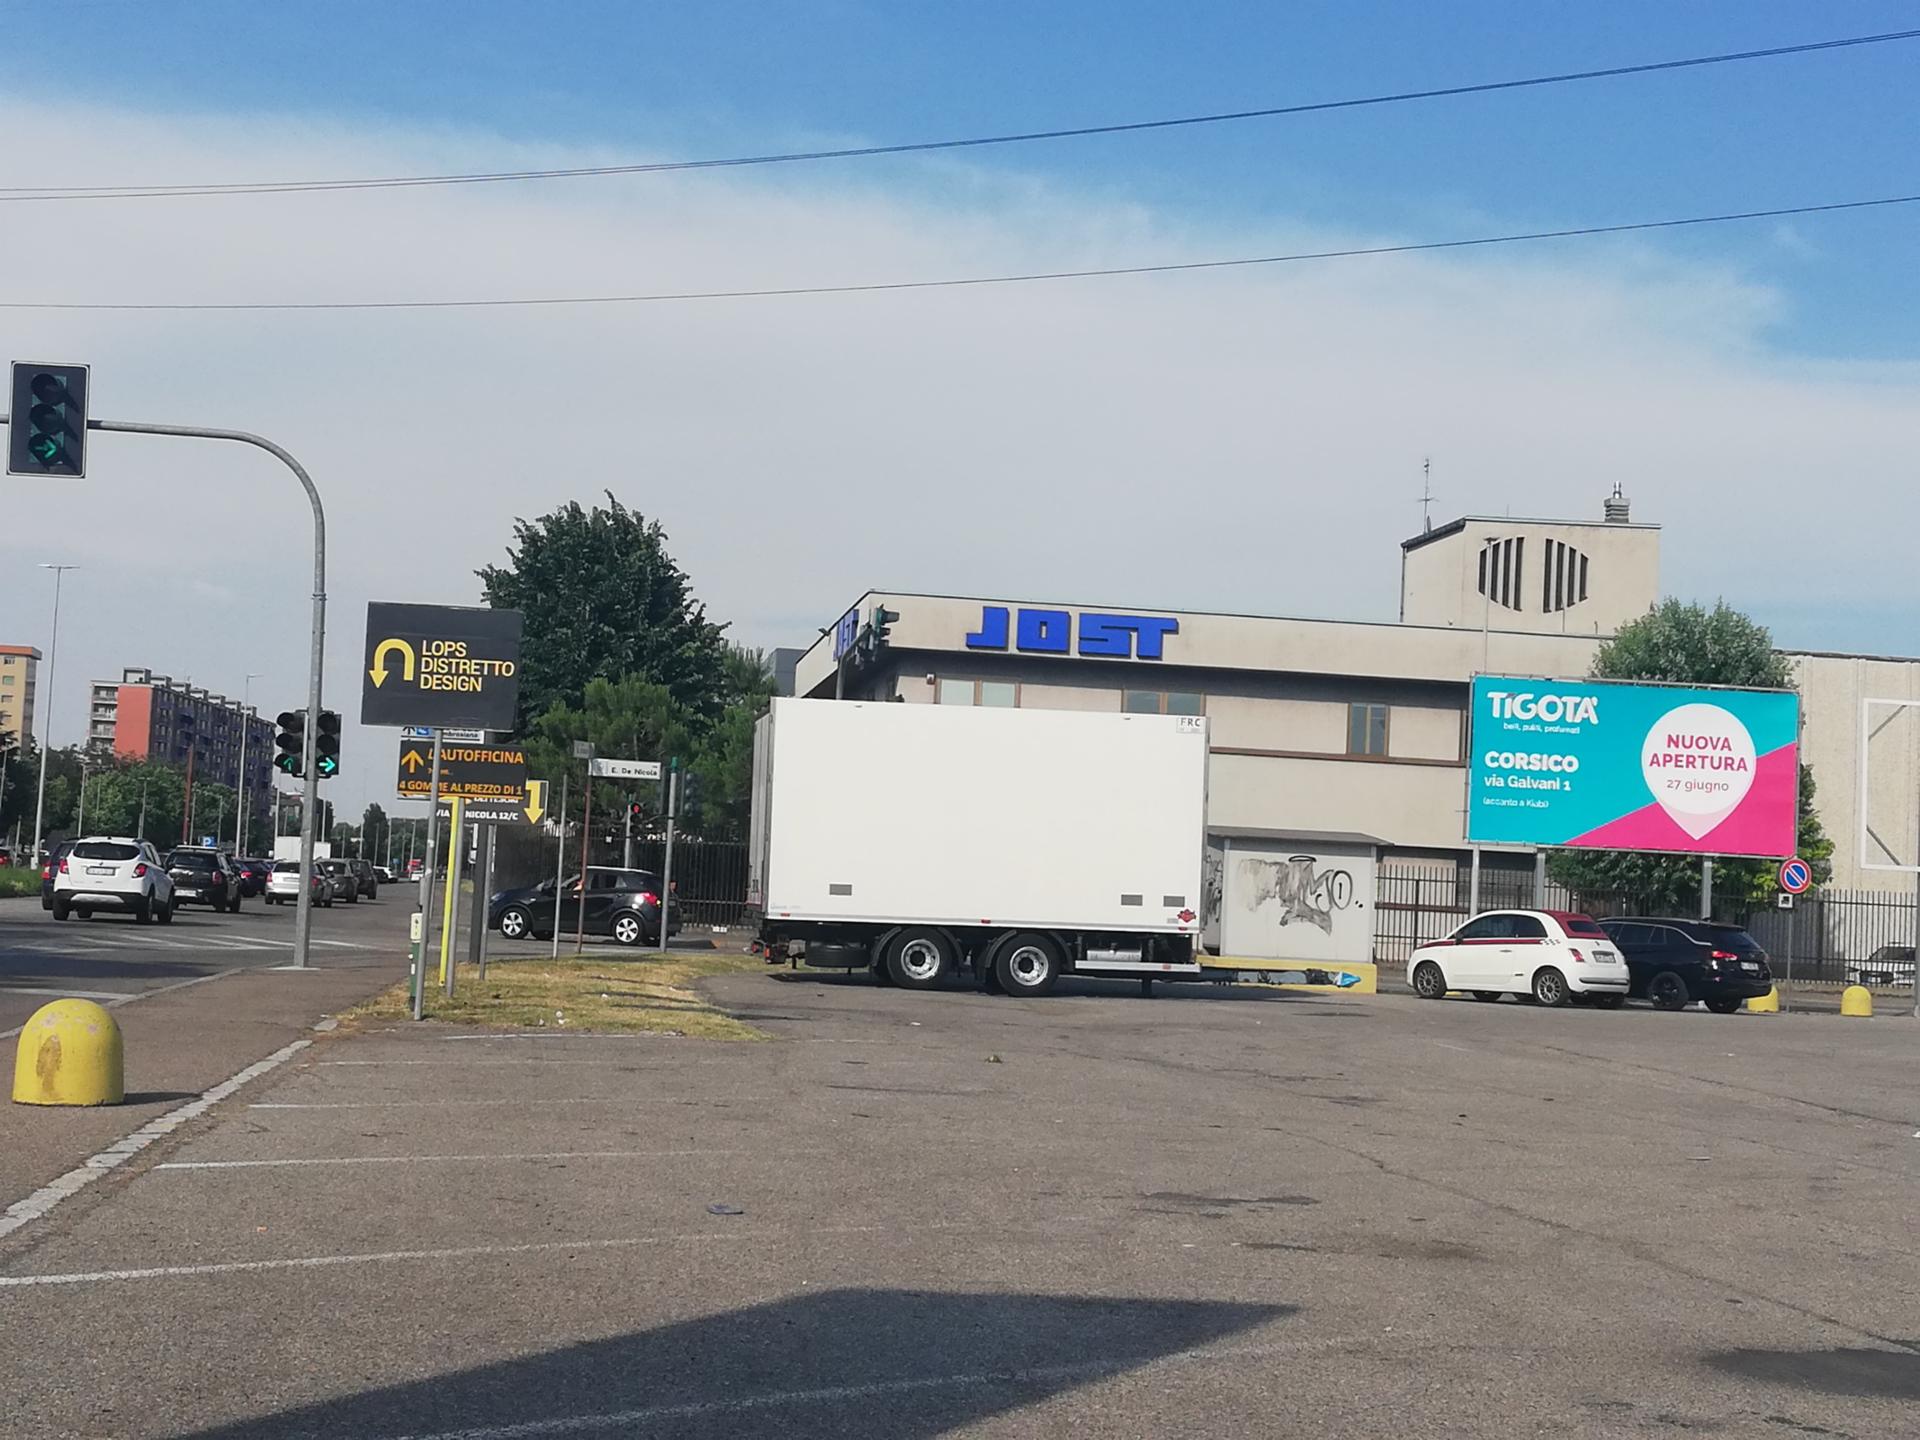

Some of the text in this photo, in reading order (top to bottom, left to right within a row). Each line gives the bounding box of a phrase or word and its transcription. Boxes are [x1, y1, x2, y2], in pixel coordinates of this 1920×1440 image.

[966, 605, 1179, 661] JOST
[422, 639, 467, 657] LOPS
[421, 657, 515, 677] DISTRETTO
[420, 674, 482, 692] DESIGN
[1667, 734, 1732, 752] NUOVA
[1484, 751, 1580, 773] CORSICO
[1649, 752, 1748, 772] APERTURA
[399, 781, 405, 789] 4
[450, 783, 463, 793] AL
[465, 784, 501, 795] PREZZO
[503, 785, 514, 795] DI
[516, 786, 523, 795] 1
[1484, 774, 1571, 791] via Galvani 1
[1667, 778, 1729, 794] 27 giugno
[465, 810, 497, 819] NICOLA
[499, 811, 518, 820] 12/C
